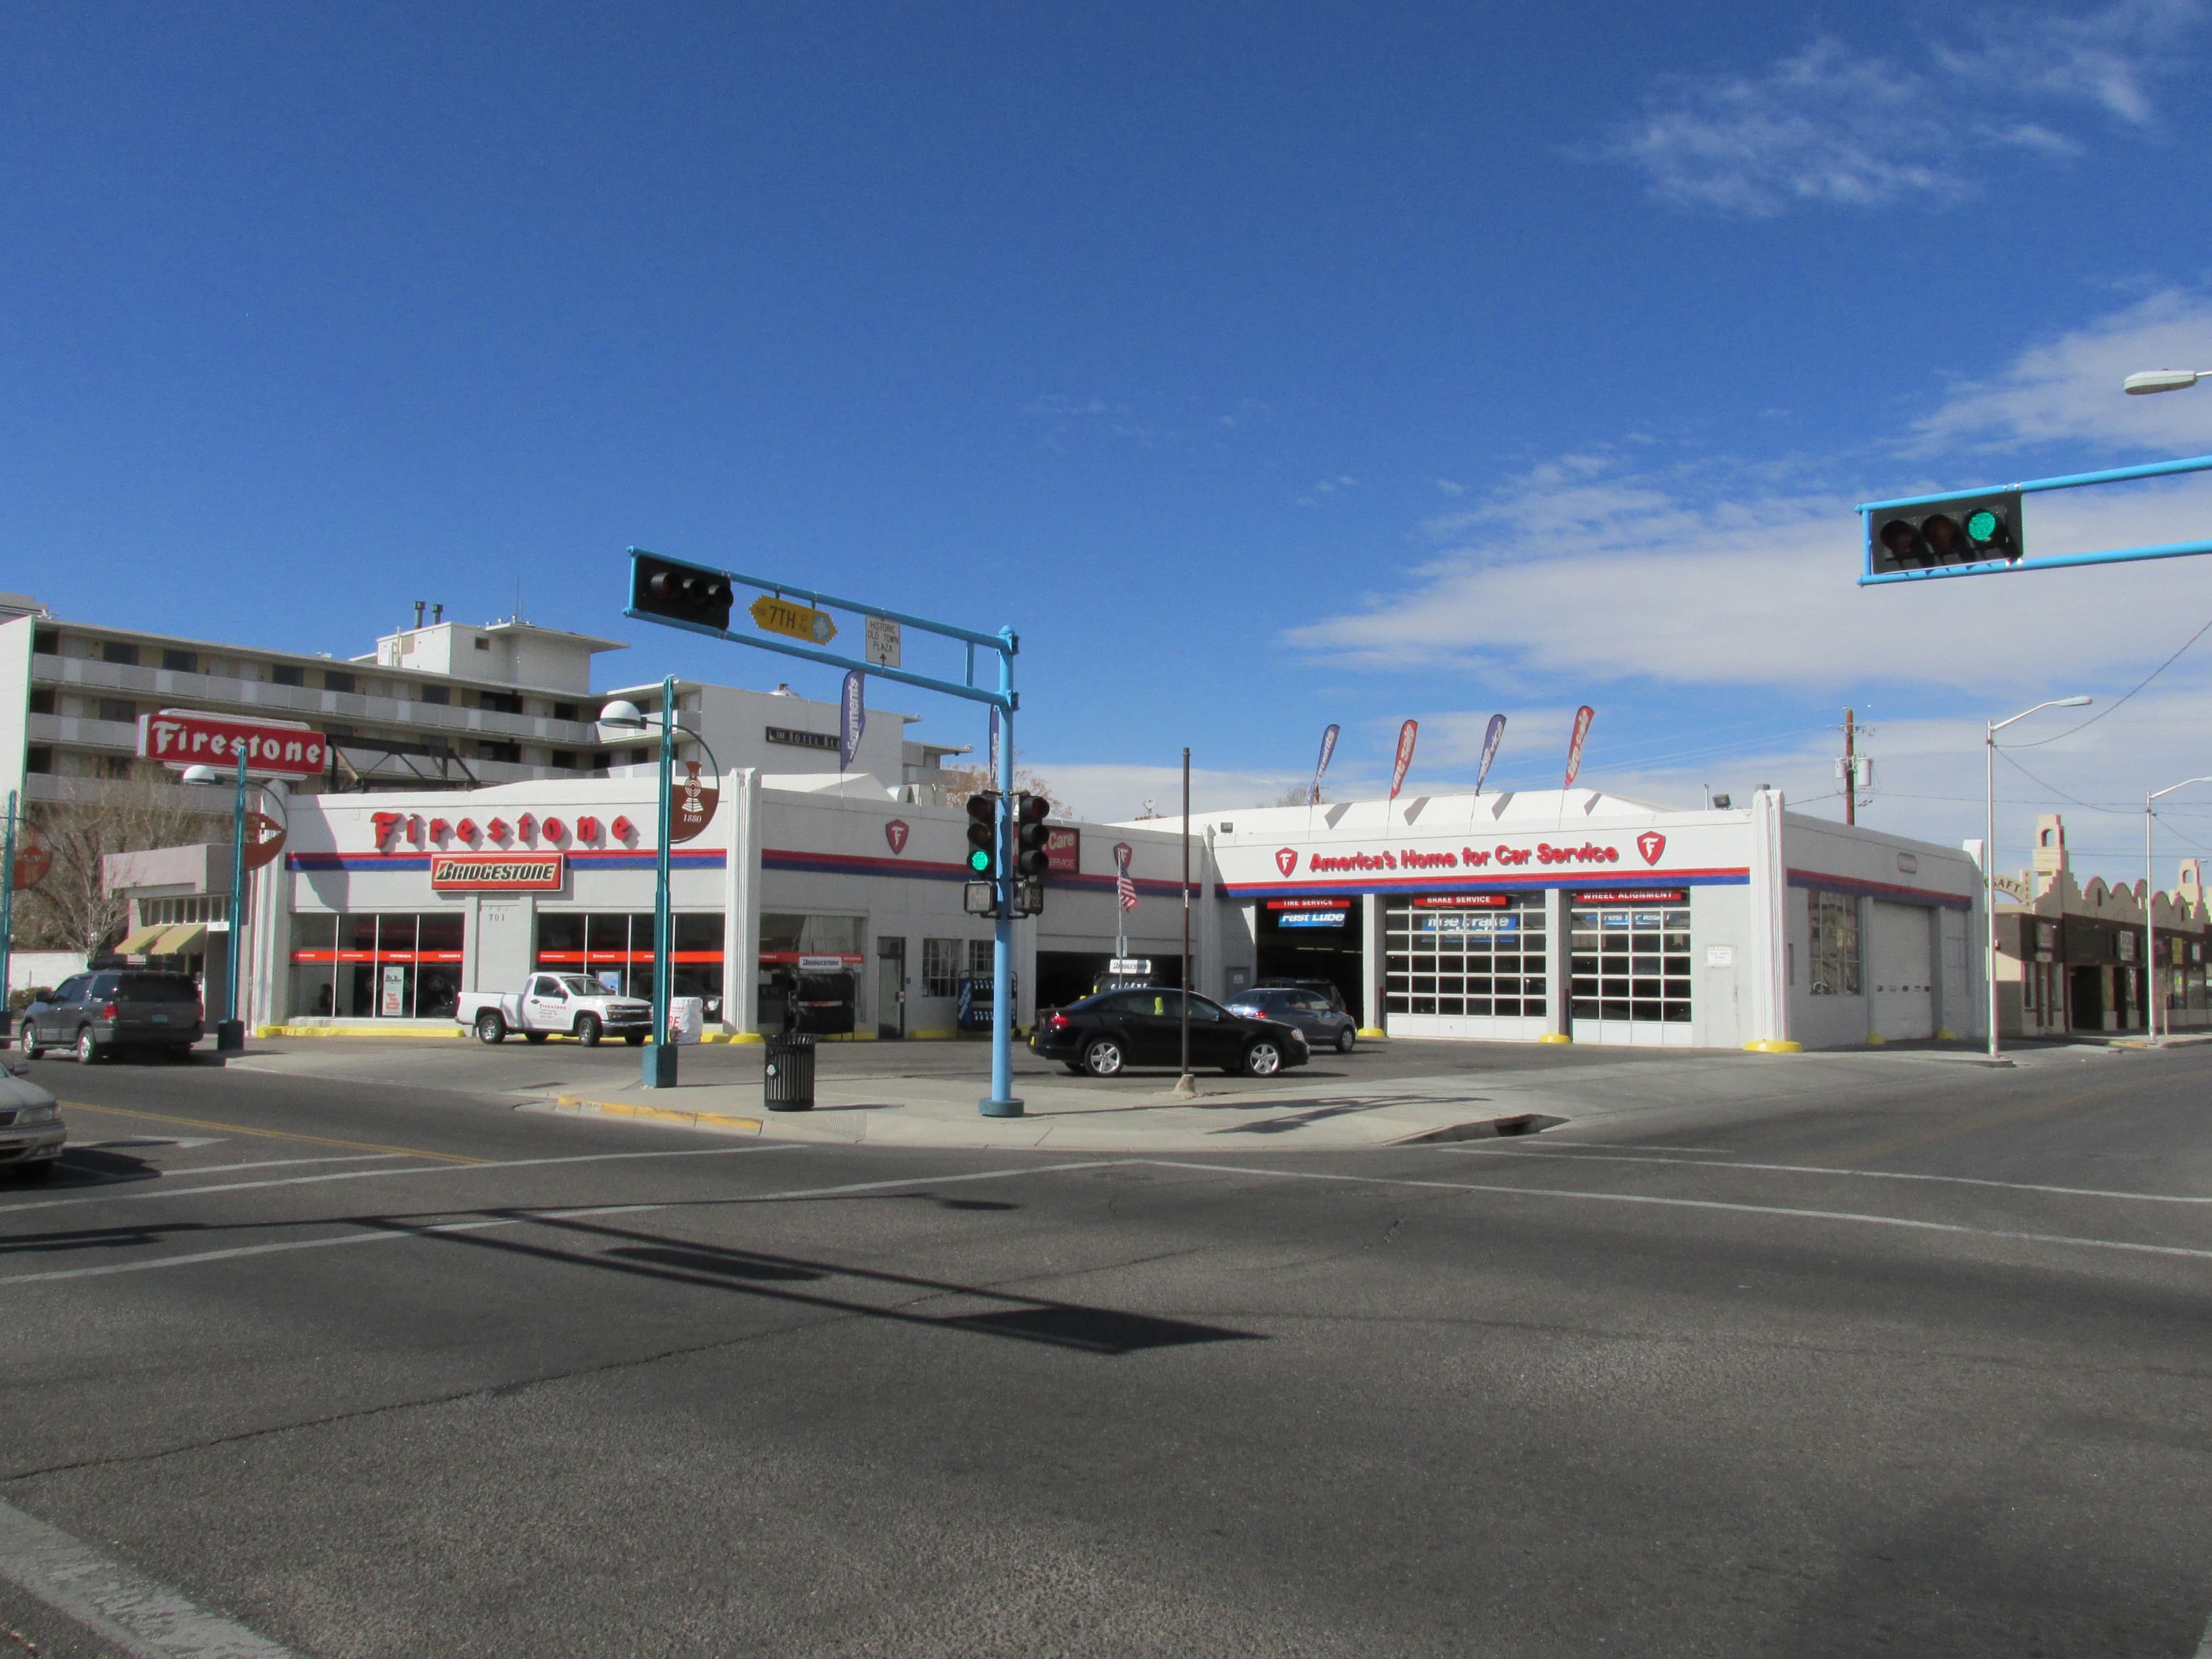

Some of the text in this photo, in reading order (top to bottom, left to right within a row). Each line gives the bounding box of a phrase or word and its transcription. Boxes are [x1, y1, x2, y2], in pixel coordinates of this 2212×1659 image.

[769, 606, 796, 629] 7TH
[869, 621, 895, 634] HISTORIC
[867, 630, 899, 644] OLD TOWN
[873, 641, 893, 652] PLAZA
[151, 720, 321, 764] Firestone
[683, 814, 702, 823] 1880
[370, 811, 632, 848] Firestone
[1049, 857, 1075, 868] ERVICE
[1309, 842, 1619, 873] America's Home for Car Service
[434, 860, 556, 881] BRIDGESTONE
[1456, 895, 1491, 903] SERVICE
[1583, 890, 1673, 900] WHEEL ALIGNMENT
[1301, 898, 1334, 906] SERVICE
[489, 914, 505, 922] 701
